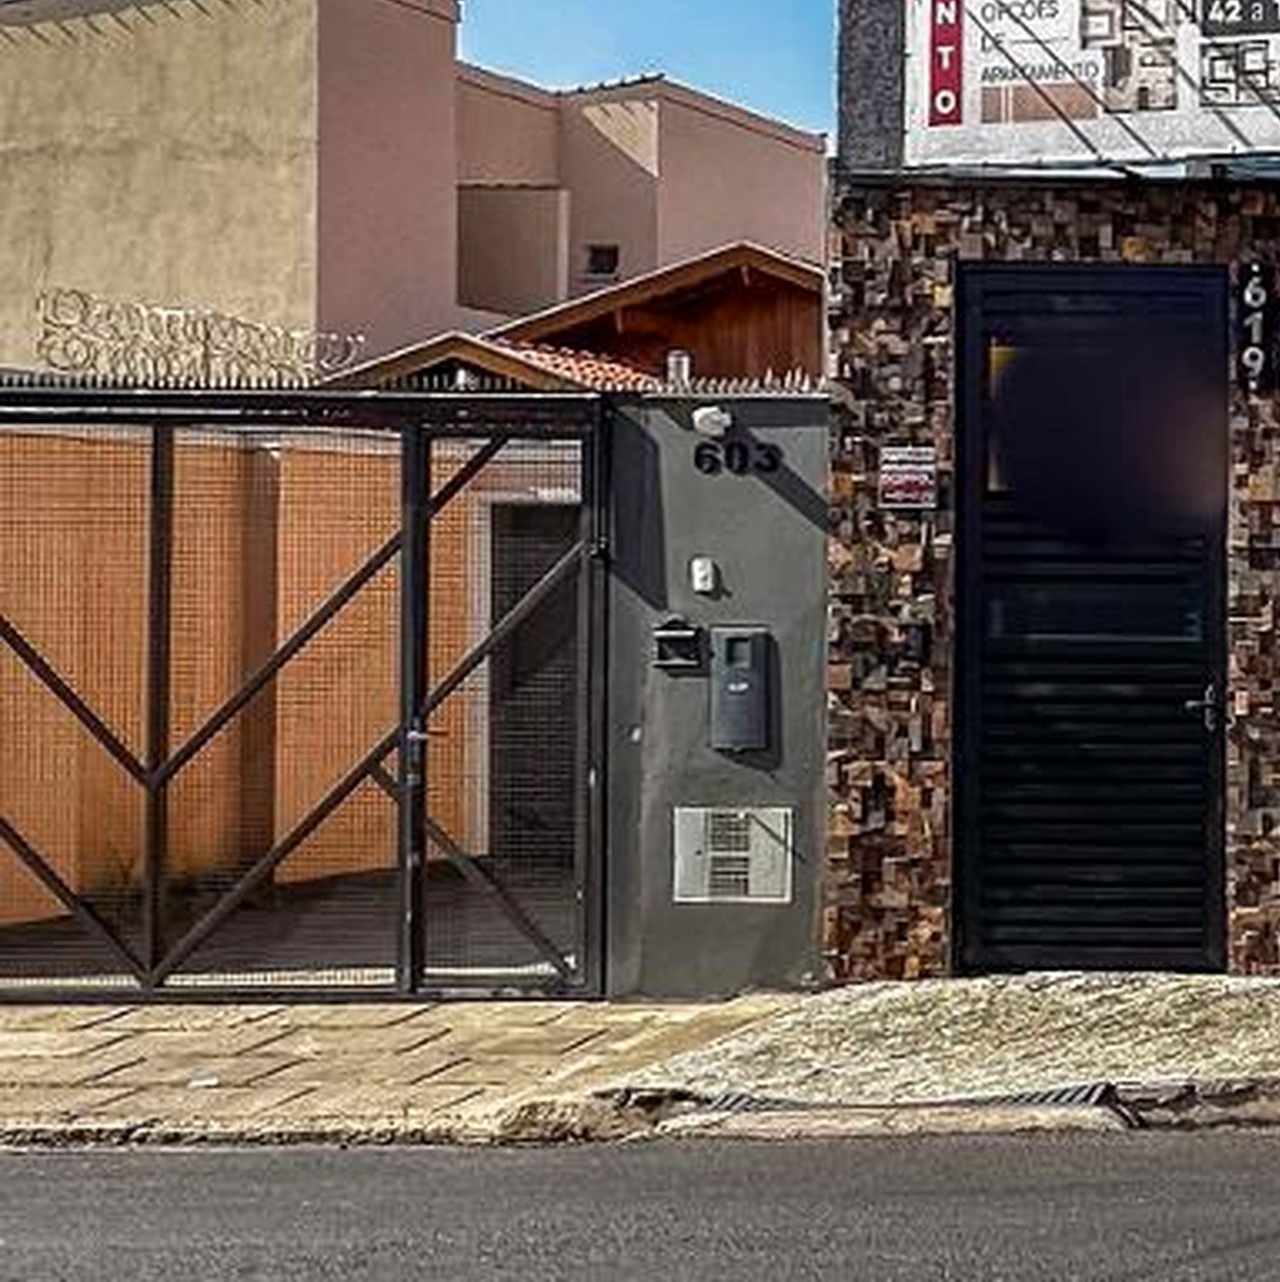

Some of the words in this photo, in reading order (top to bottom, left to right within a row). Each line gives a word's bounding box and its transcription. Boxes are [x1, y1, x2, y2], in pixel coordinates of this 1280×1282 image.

[1208, 0, 1243, 23] 42
[1241, 275, 1267, 378] 619
[694, 439, 785, 476] 603
